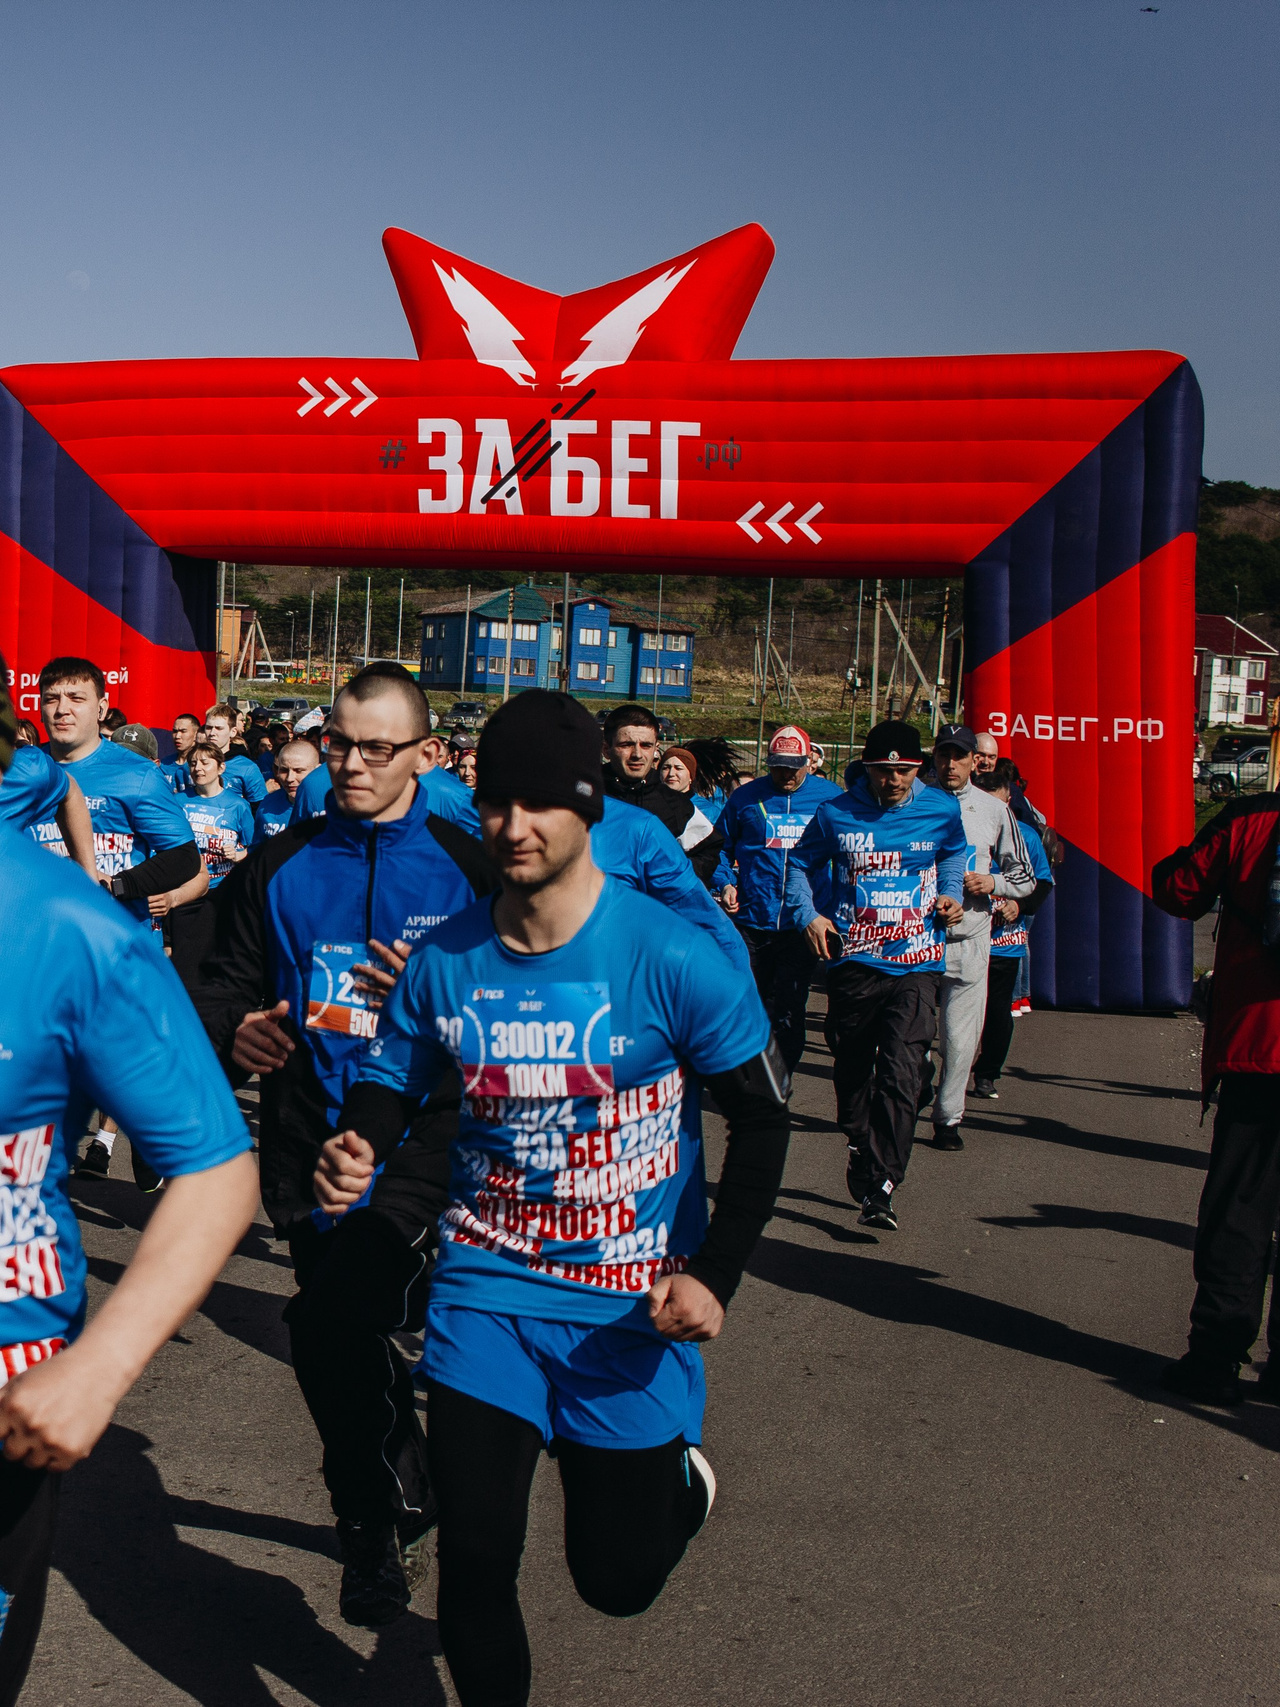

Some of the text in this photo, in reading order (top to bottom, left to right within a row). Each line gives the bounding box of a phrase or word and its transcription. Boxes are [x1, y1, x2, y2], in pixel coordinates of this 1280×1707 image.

[988, 712, 1164, 742] ЗАБЕГ.РФ
[37, 822, 64, 842] 200
[838, 832, 875, 852] 2024
[92, 832, 135, 855] ЦЕЛЬ
[870, 891, 911, 907] 30025
[402, 929, 427, 941] РОС
[333, 945, 353, 955] ПСБ
[484, 990, 505, 999] ПСБ
[490, 1021, 577, 1059] 30012
